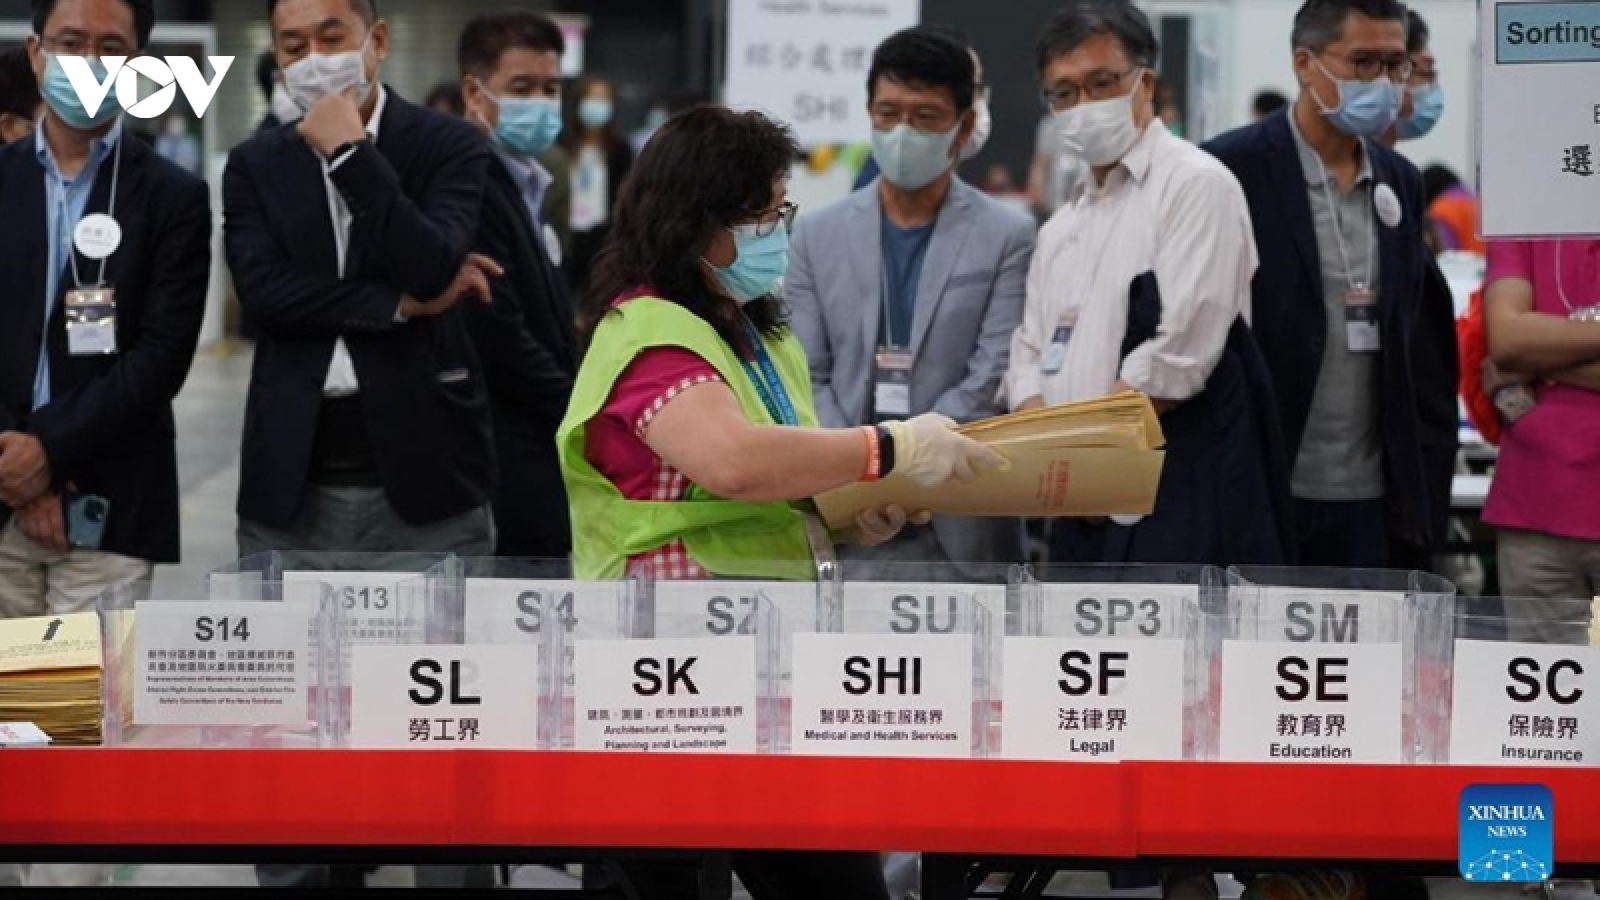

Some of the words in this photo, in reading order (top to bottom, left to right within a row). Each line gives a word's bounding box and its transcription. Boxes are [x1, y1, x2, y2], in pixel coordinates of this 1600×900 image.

[1506, 20, 1600, 48] Sorting
[1562, 144, 1600, 176] 選
[342, 586, 388, 610] S13
[890, 594, 957, 633] SU
[1074, 598, 1161, 637] SP3
[1284, 601, 1359, 643] SM
[195, 616, 250, 642] S14
[408, 658, 482, 706] SL
[632, 656, 700, 696] SK
[842, 656, 922, 695] SHI
[1058, 650, 1128, 696] SF
[1275, 656, 1348, 701] SE
[1506, 656, 1584, 704] SC
[409, 718, 480, 741] 勞工界
[1058, 708, 1127, 731] 法律界
[1276, 714, 1346, 736] 教育界
[1508, 714, 1578, 740] 保險界
[804, 730, 846, 740] Medical
[850, 730, 870, 740] and
[912, 730, 958, 741] Services
[1070, 738, 1114, 756] Legal
[1270, 743, 1352, 758] Education
[1502, 744, 1583, 761] Insurance
